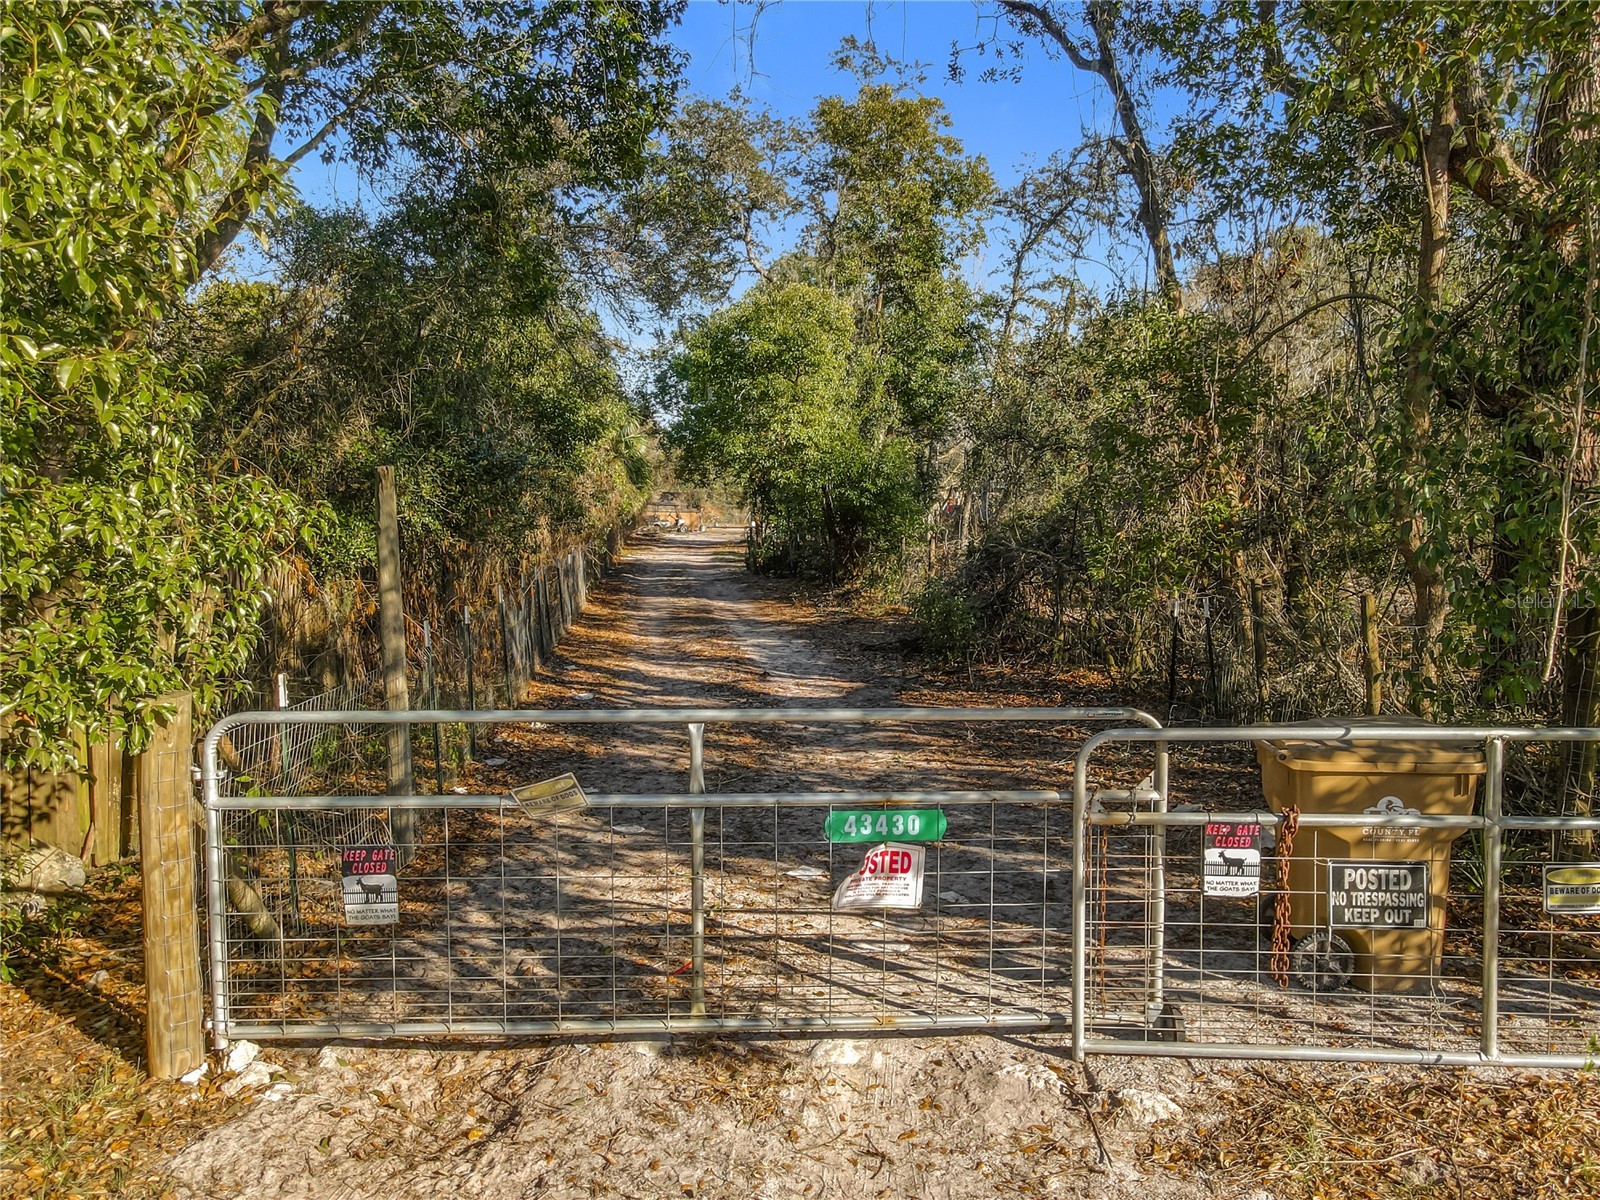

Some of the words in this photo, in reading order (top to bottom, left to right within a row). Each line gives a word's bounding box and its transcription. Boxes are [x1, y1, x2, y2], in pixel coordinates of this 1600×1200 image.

[844, 814, 920, 836] 43430
[1206, 824, 1230, 835] KEEP
[1237, 825, 1260, 835] GATE
[1215, 837, 1251, 847] CLOSED
[343, 850, 366, 861] KEEP
[372, 850, 395, 860] GATE
[352, 862, 387, 873] CLOSED
[1344, 868, 1412, 890] POSTED
[1332, 891, 1346, 906] NO
[1351, 891, 1424, 907] TRESPASSING
[1344, 908, 1380, 922] KEEP
[1384, 909, 1411, 923] OUT
